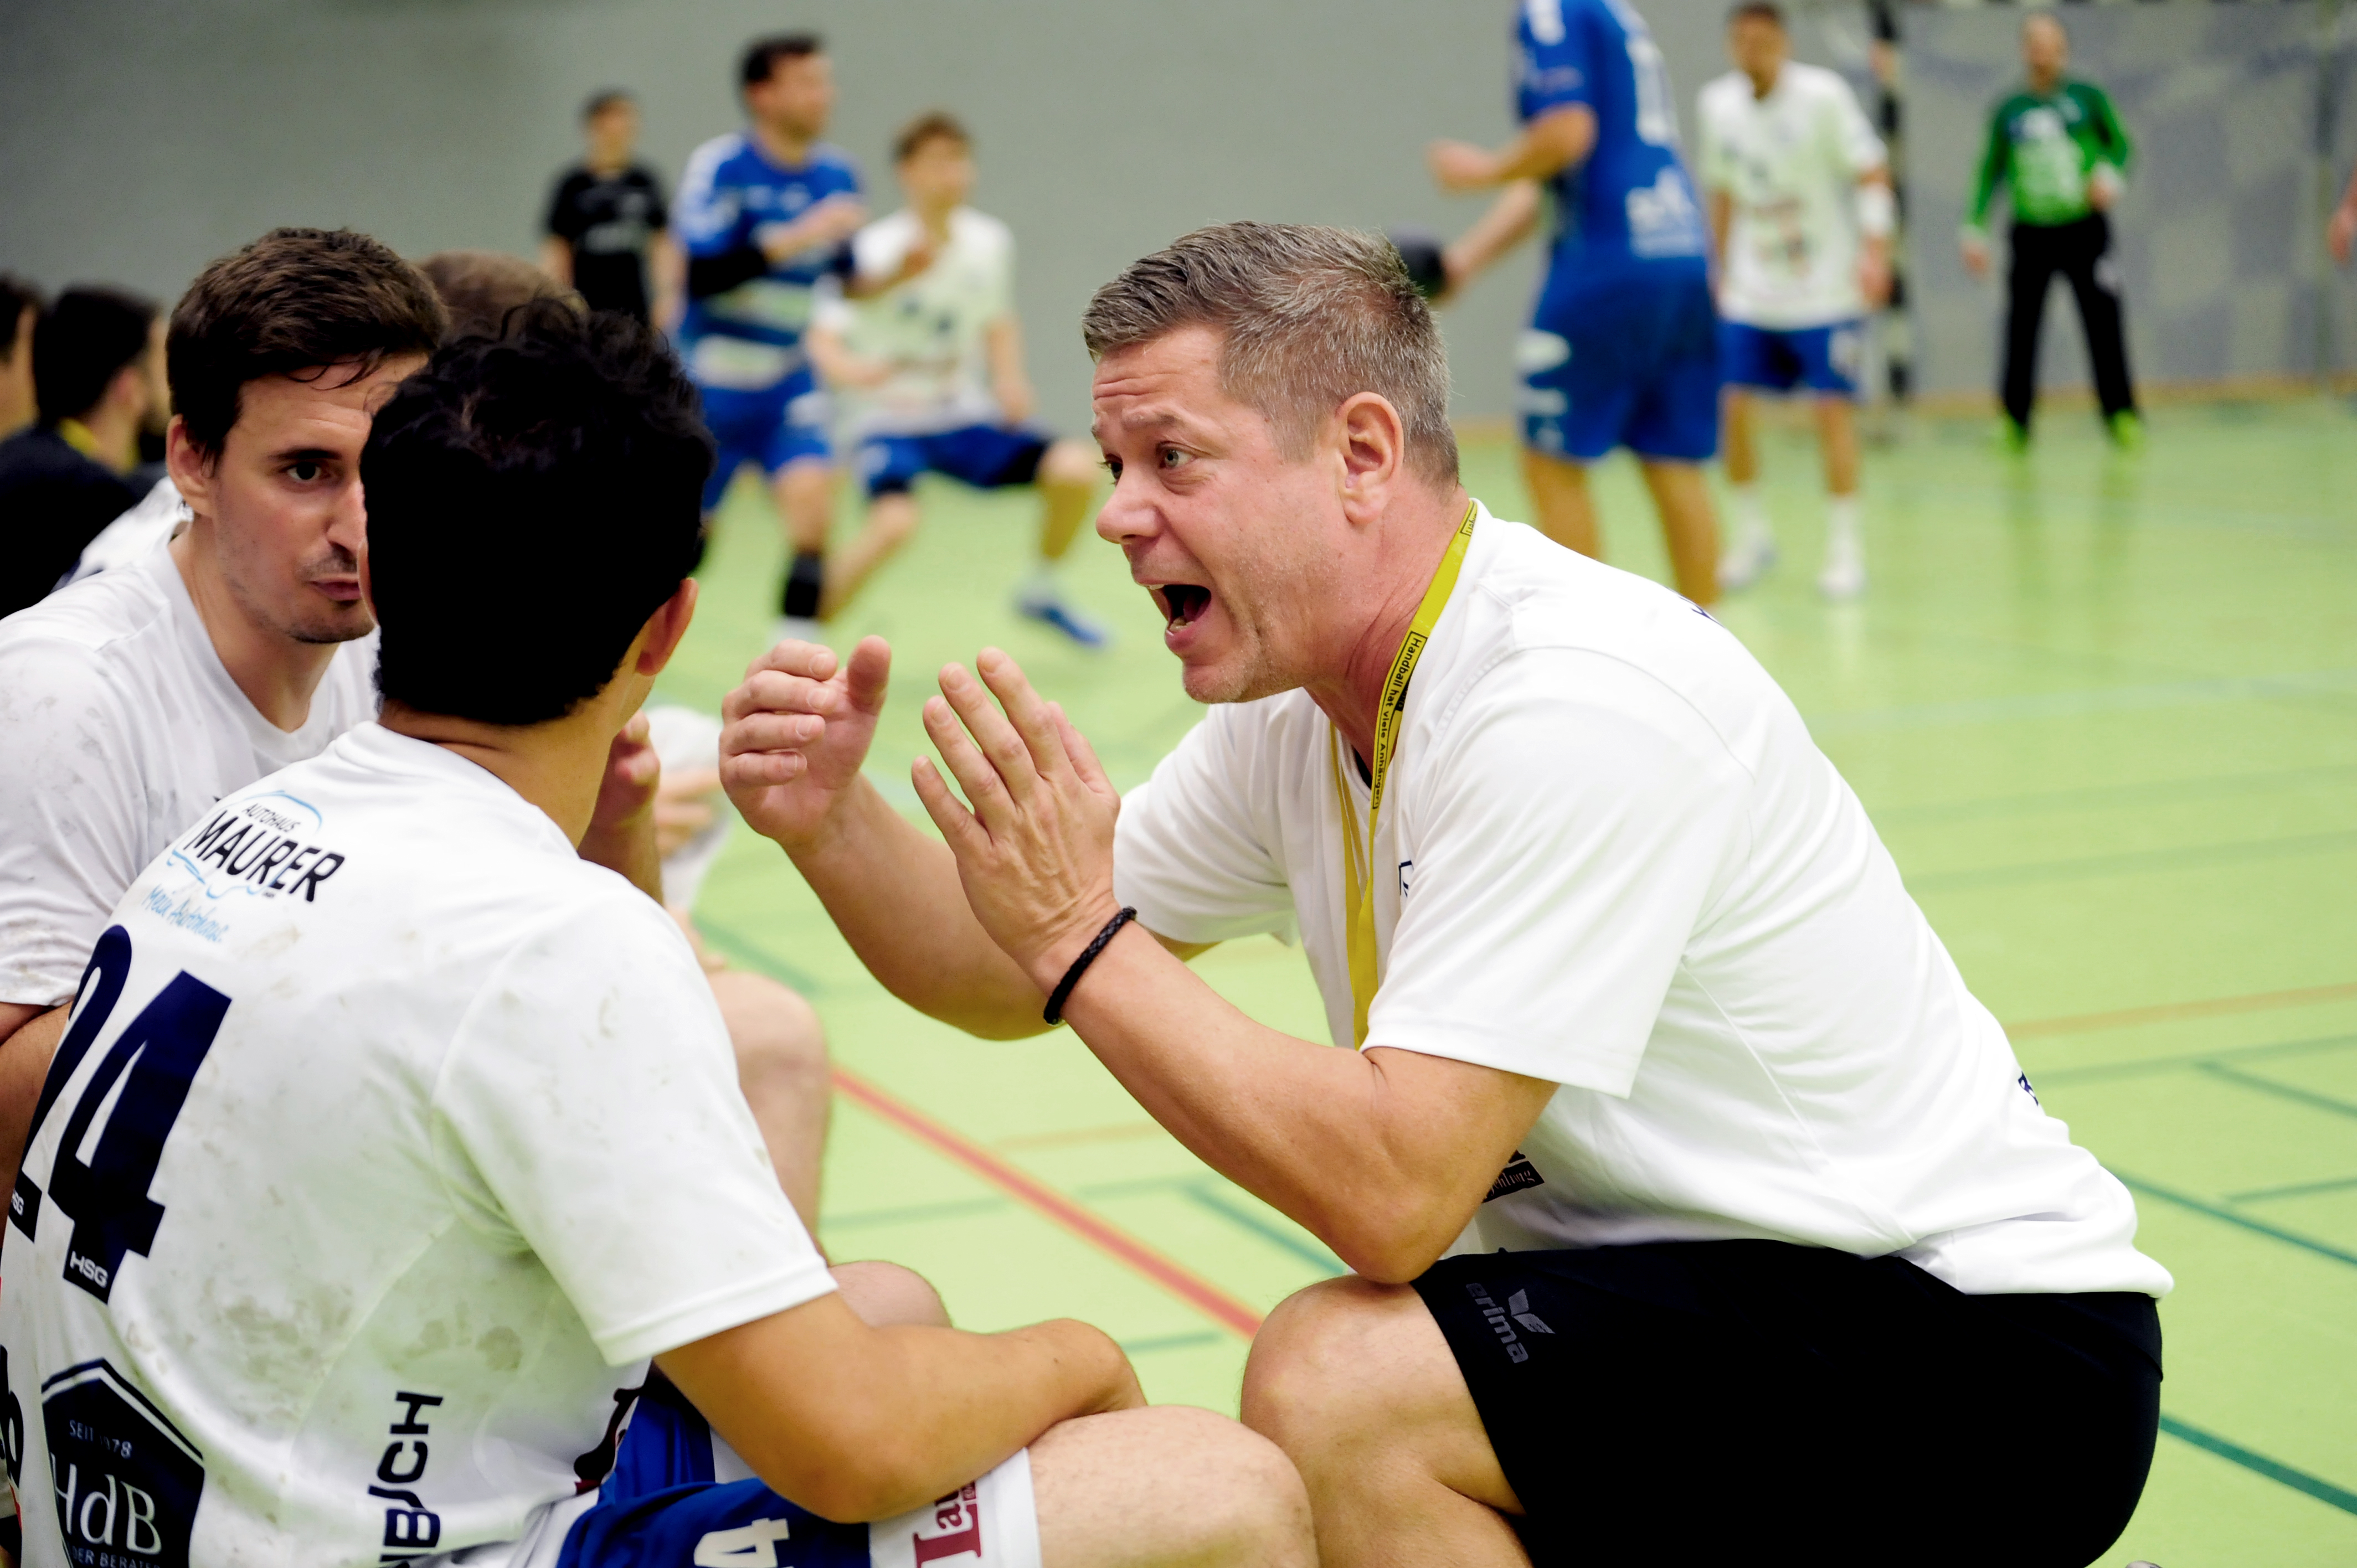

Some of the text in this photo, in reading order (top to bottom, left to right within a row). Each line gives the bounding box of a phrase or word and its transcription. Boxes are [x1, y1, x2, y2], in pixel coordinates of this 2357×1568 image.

[1393, 637, 1422, 688] Handball
[1386, 689, 1400, 708] hat
[1381, 710, 1390, 739] viele
[241, 802, 301, 833] AUTOHAUS
[182, 809, 345, 902] MAURER
[11, 1188, 24, 1216] SG
[69, 1250, 109, 1288] HSG
[1465, 1282, 1529, 1364] erima
[69, 1419, 94, 1442] SEIT
[50, 1451, 162, 1555] HdB
[694, 1518, 794, 1568] 4
